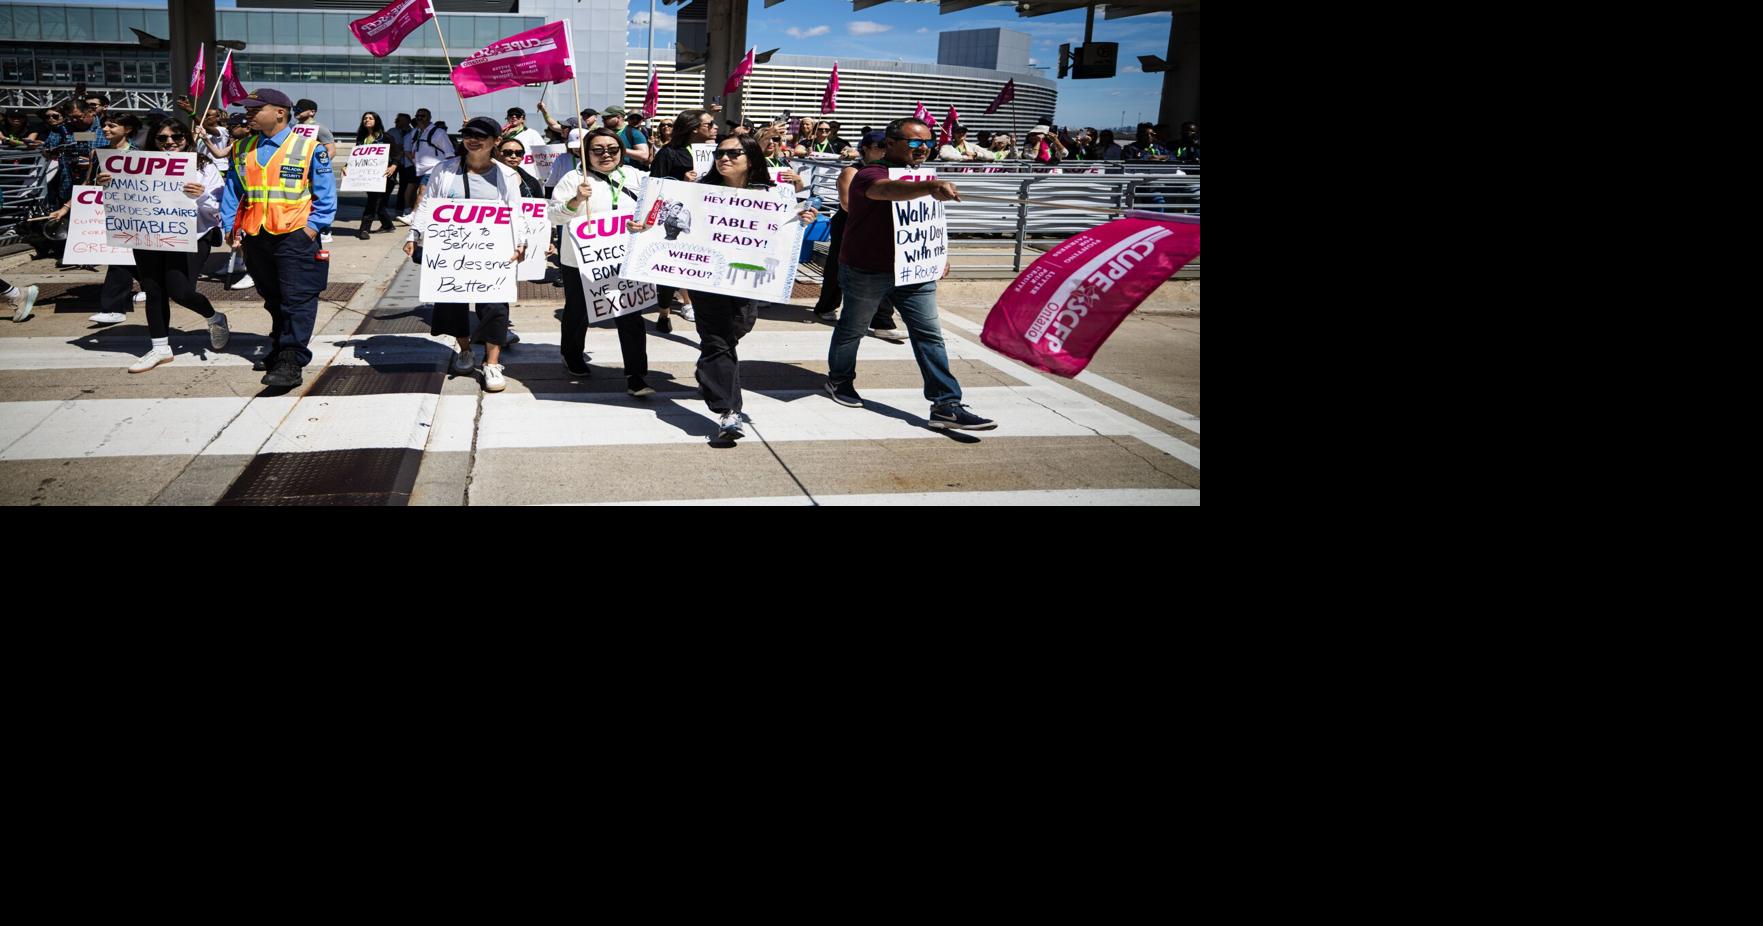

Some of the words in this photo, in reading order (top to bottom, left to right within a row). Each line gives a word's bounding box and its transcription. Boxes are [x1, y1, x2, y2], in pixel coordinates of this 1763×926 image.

[293, 127, 315, 138] PE
[352, 146, 386, 157] CUPE
[695, 149, 712, 163] PAY
[105, 155, 189, 176] CUPE
[104, 191, 119, 201] DE
[703, 195, 727, 205] HEY
[729, 196, 788, 213] HONEY!
[105, 204, 127, 214] SUR
[128, 207, 151, 216] DES
[432, 204, 513, 225] CUPE
[521, 202, 546, 218] PE
[895, 200, 930, 226] Walk
[708, 214, 759, 231] TABLE
[767, 223, 779, 232] IS
[427, 223, 472, 242] Safety
[479, 226, 491, 237] to
[712, 232, 768, 249] READY!
[896, 227, 927, 247] Duty
[441, 238, 495, 251] Service
[425, 253, 448, 270] We
[453, 254, 512, 271] deserve
[668, 249, 711, 264] WHERE
[592, 262, 623, 281] BON
[651, 263, 677, 275] ARE
[677, 266, 713, 280] YOU?
[1088, 239, 1155, 293] CUPE
[437, 276, 507, 293] Better!!
[589, 283, 610, 298] WE
[593, 283, 656, 318] EXCUSES
[1025, 301, 1059, 338] Ontario
[1044, 297, 1089, 354] SCFP
